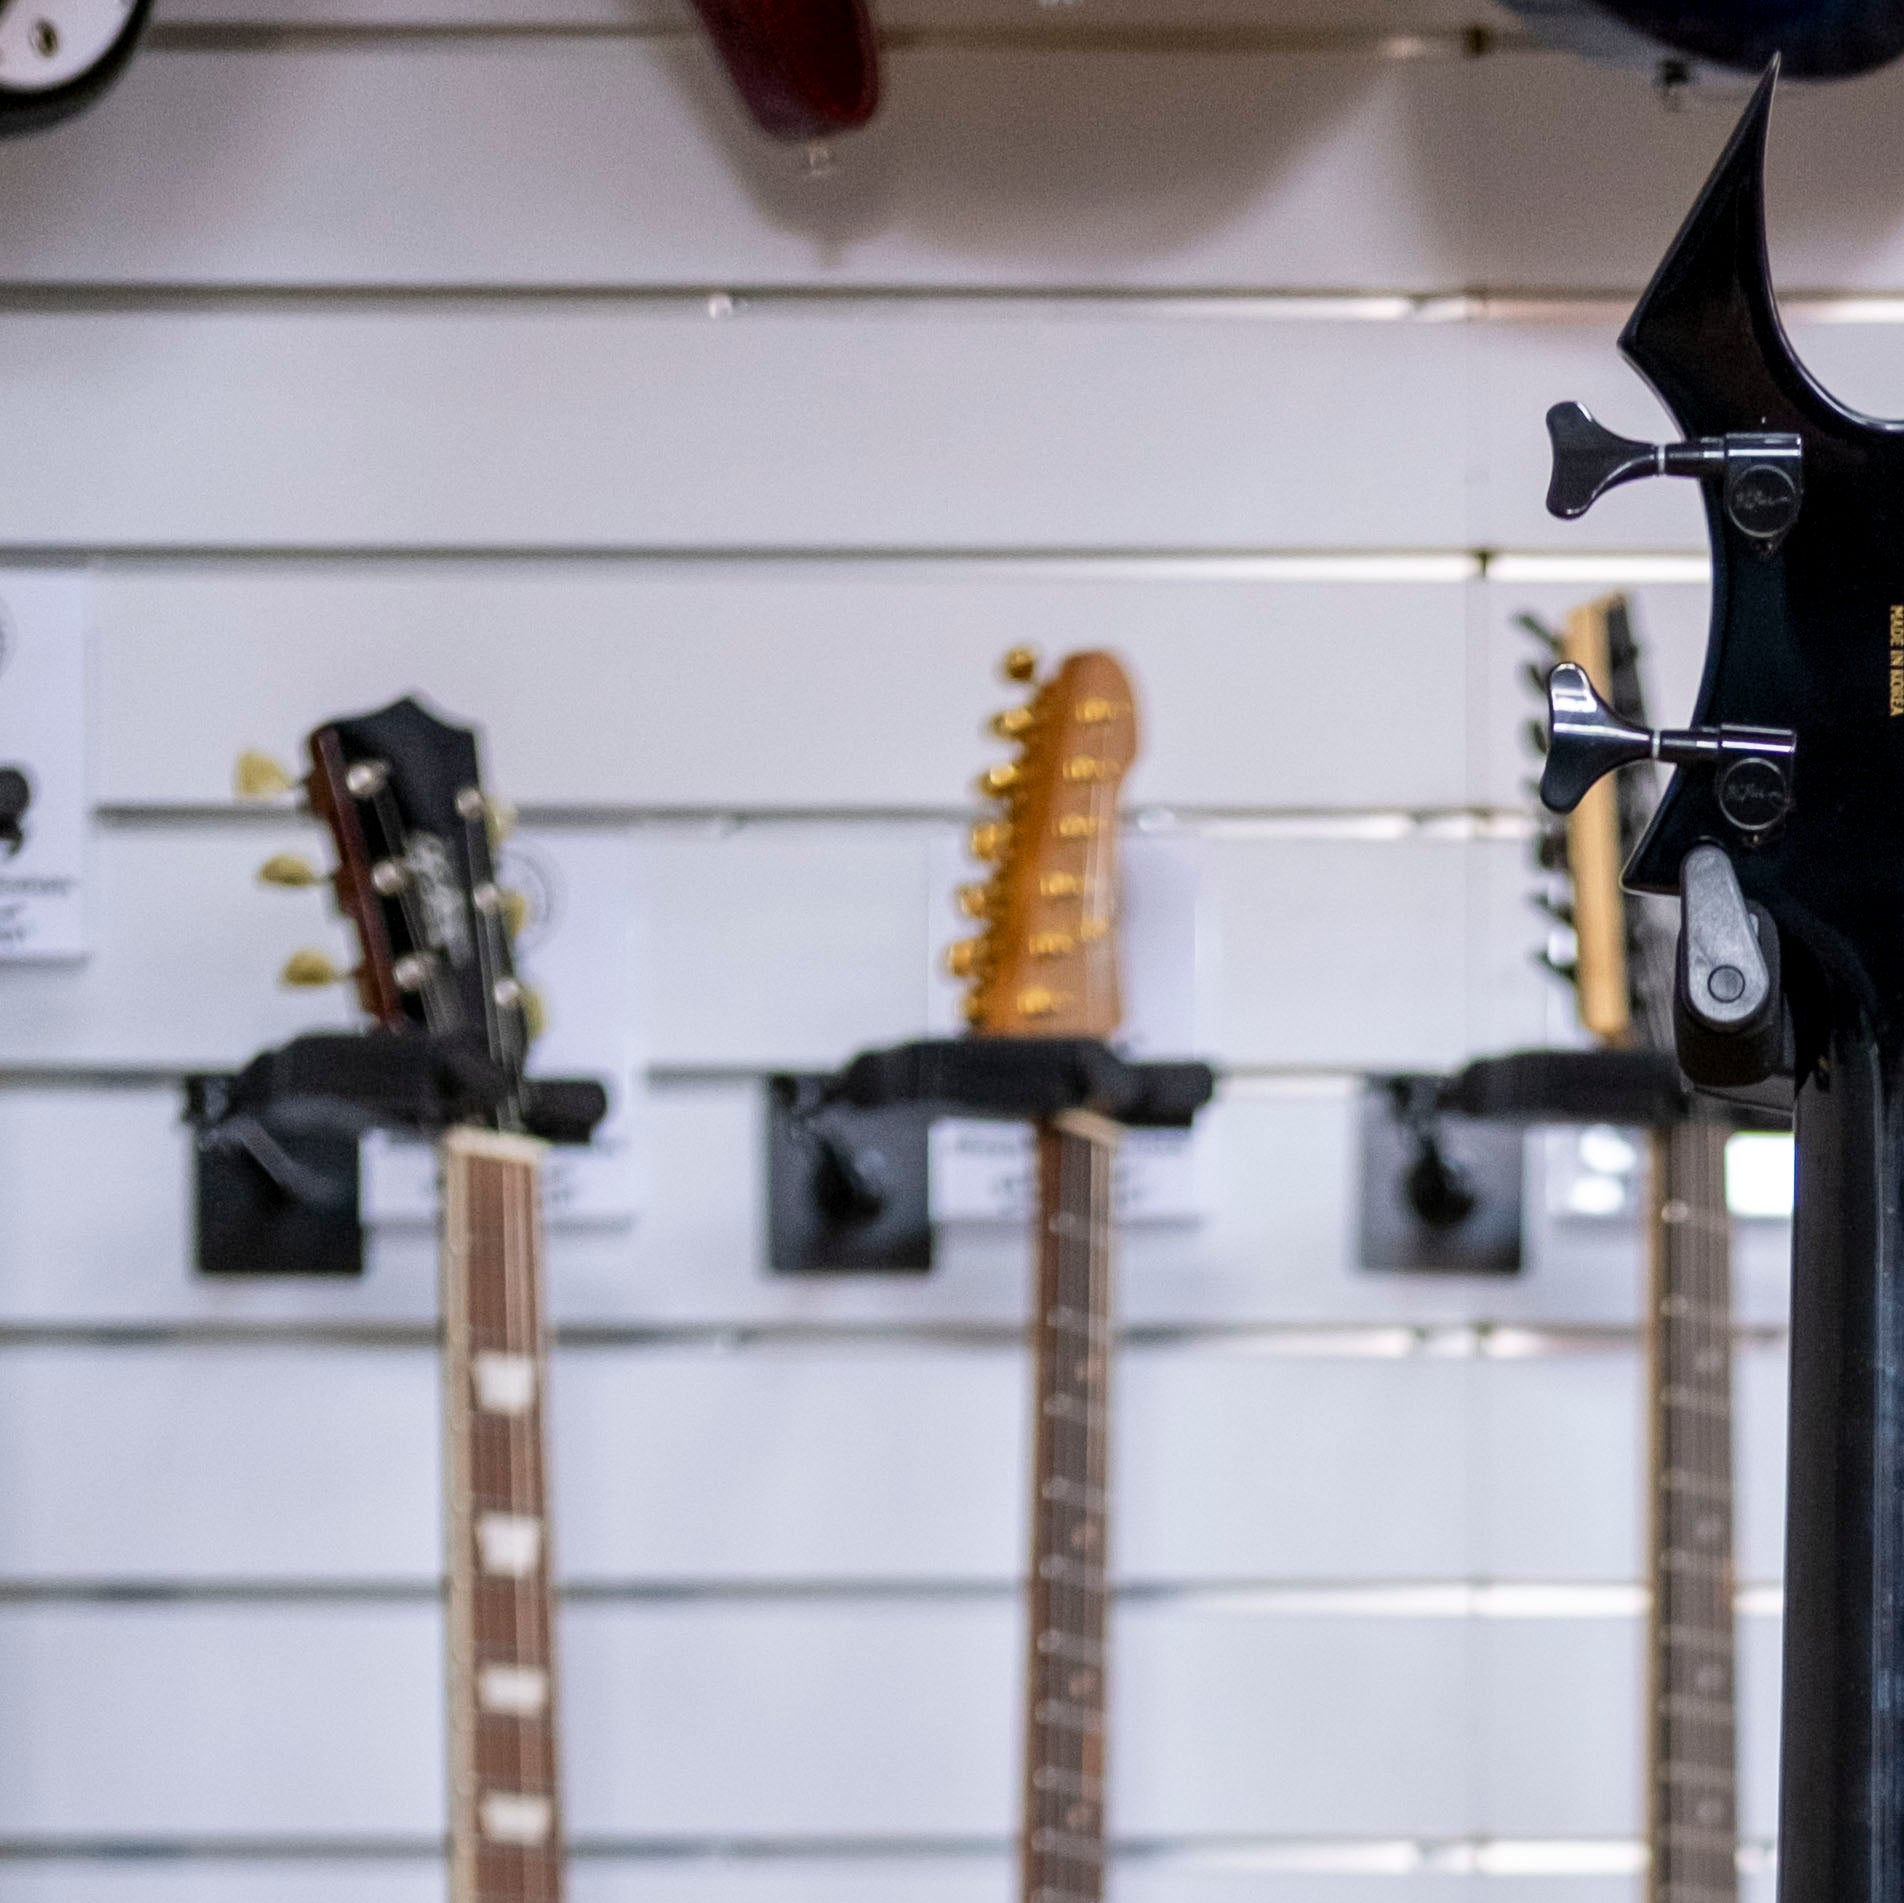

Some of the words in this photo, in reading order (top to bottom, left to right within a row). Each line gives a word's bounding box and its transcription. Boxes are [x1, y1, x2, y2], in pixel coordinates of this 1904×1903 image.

[1890, 604, 1904, 646] MADE
[1890, 650, 1904, 666] IN
[1890, 668, 1904, 717] KOREA
